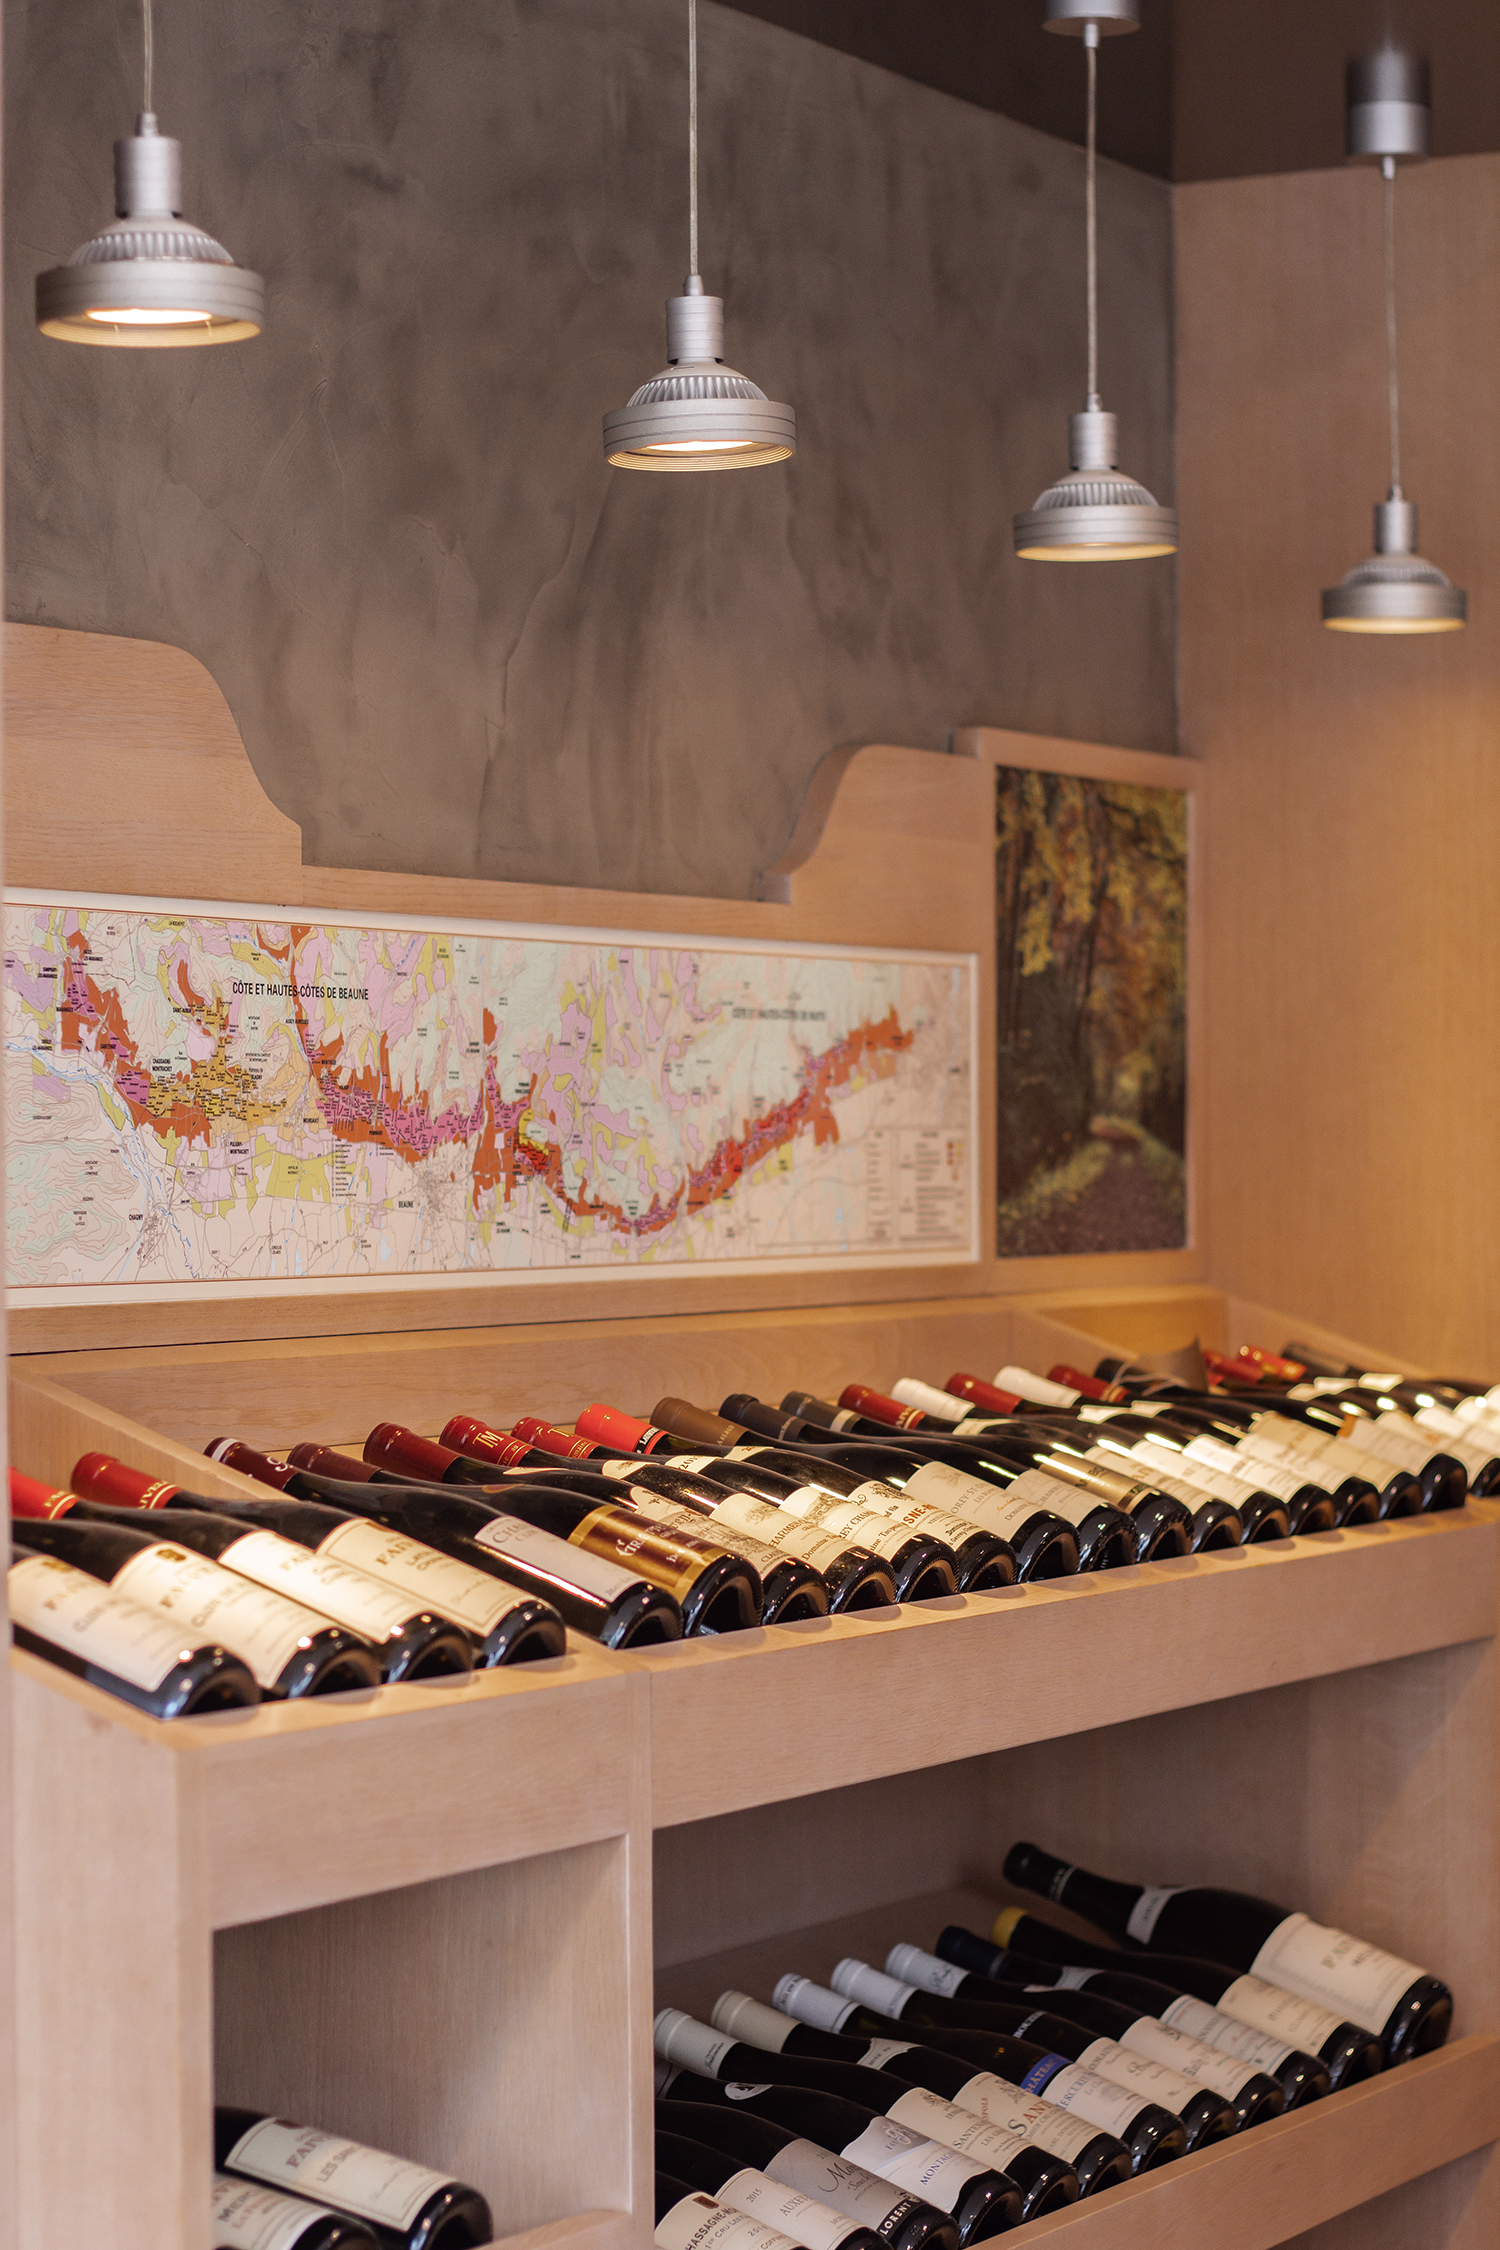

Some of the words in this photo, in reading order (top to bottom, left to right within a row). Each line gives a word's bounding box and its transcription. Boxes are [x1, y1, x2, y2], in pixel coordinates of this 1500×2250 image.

[232, 979, 253, 994] CÔTE
[255, 983, 265, 996] ET
[266, 983, 325, 998] HAUTES-CÔTES
[326, 986, 337, 999] DE
[338, 987, 369, 1000] BEAUNE
[768, 1516, 807, 1549] HARMES
[745, 2187, 763, 2204] 2015
